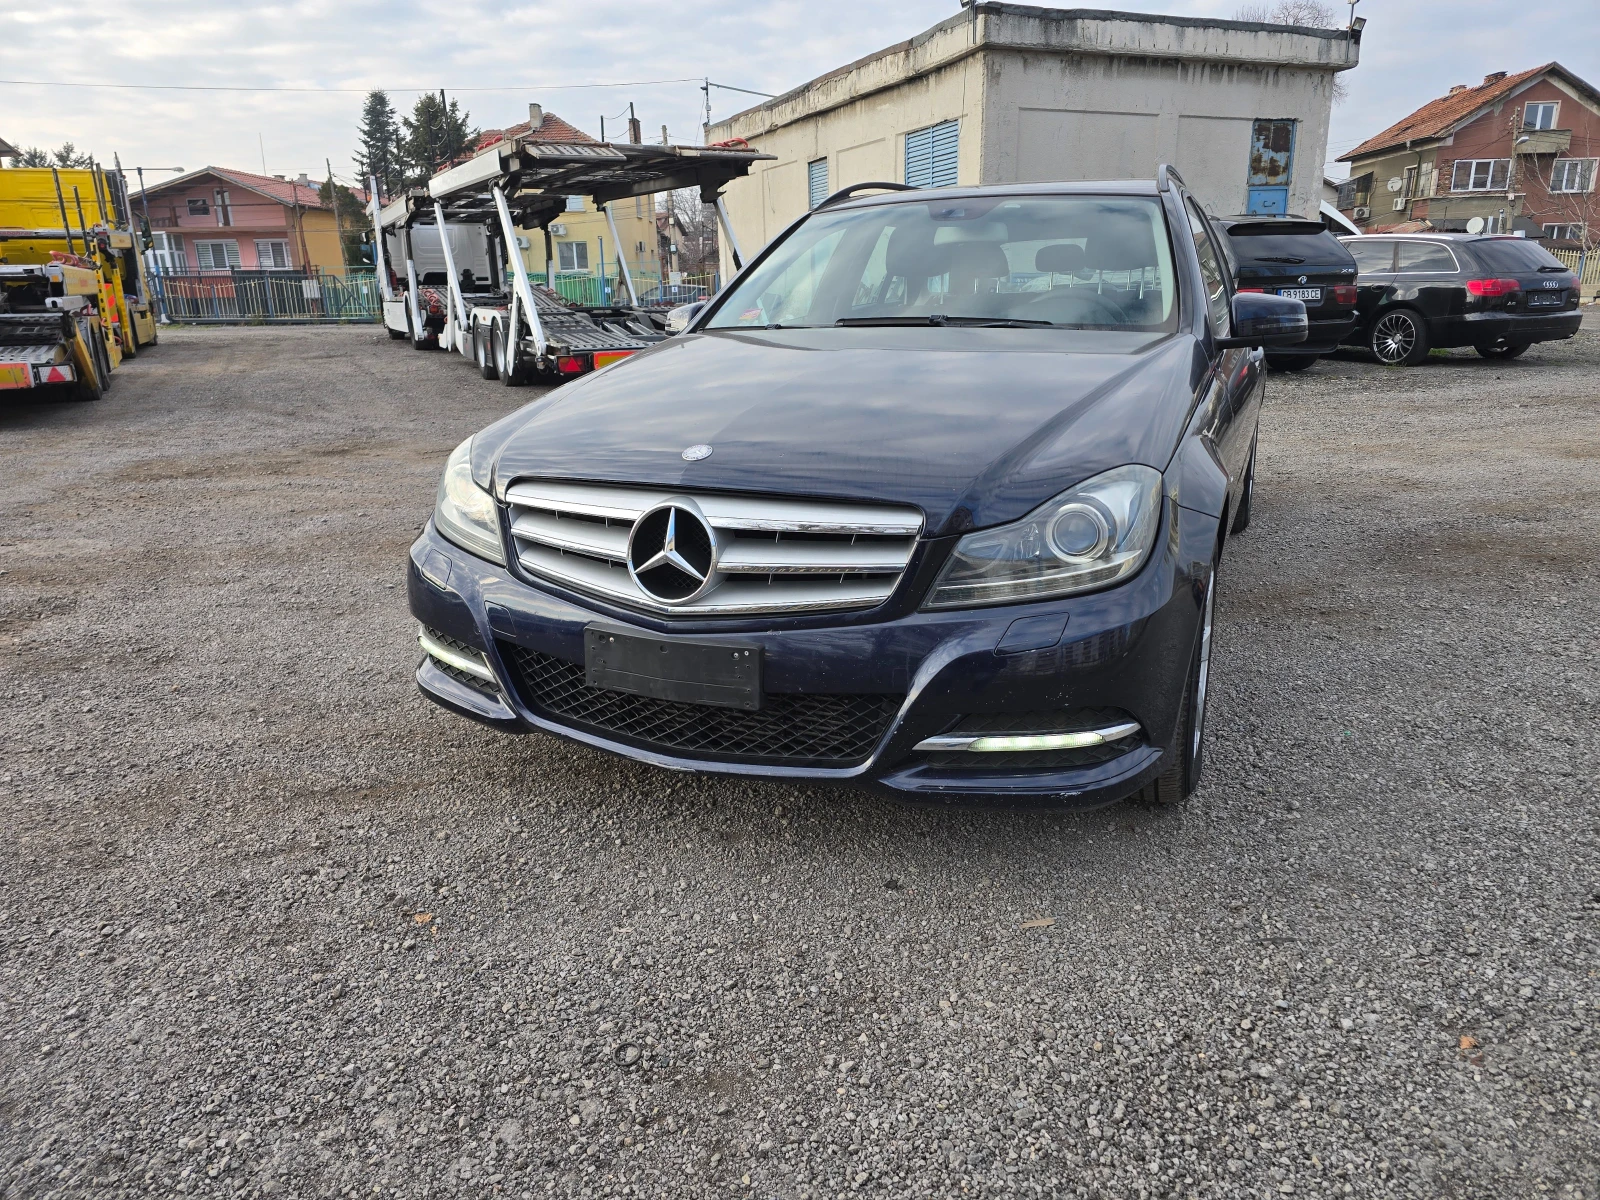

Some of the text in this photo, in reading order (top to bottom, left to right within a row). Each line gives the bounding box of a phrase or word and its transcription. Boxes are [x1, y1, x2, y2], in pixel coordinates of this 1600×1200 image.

[1282, 289, 1320, 299] CB 9183 CE
